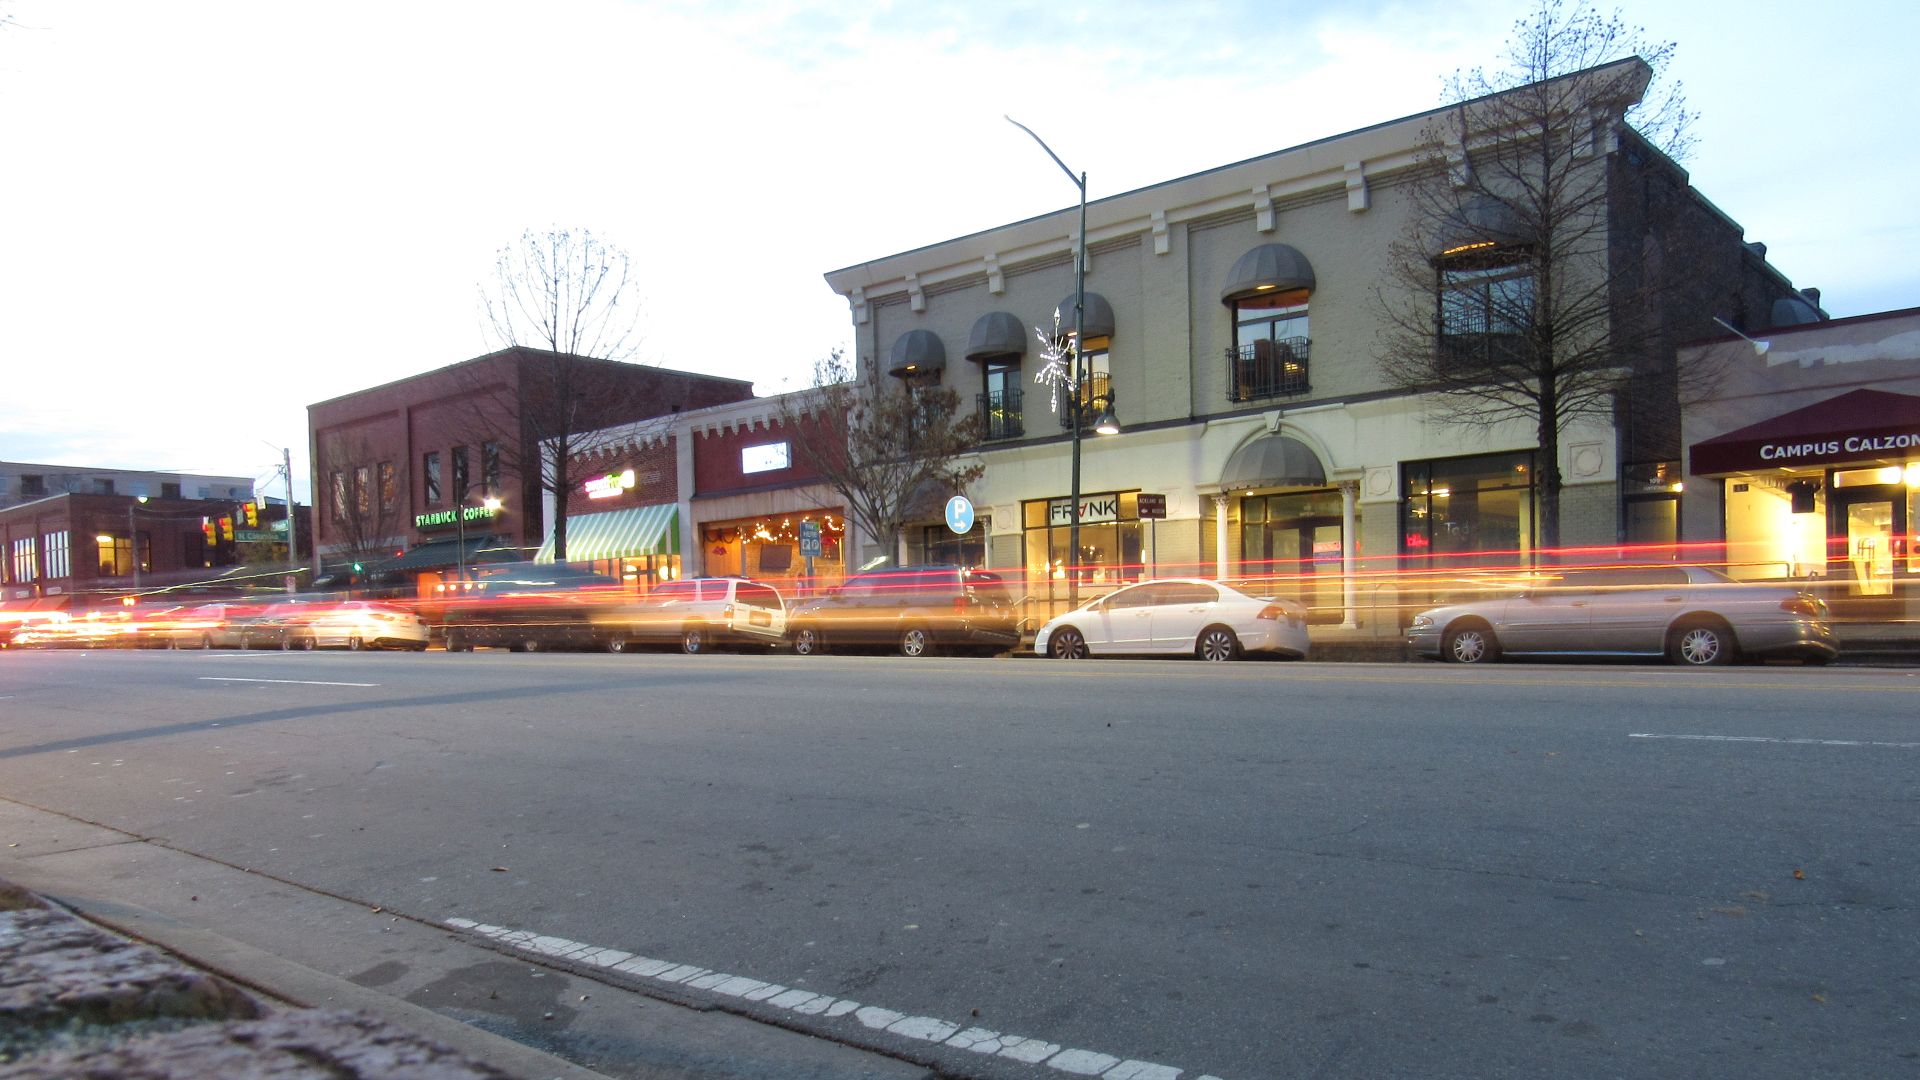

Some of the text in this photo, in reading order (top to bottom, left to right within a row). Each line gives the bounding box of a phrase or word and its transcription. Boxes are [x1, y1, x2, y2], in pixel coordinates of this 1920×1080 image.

[1760, 441, 1839, 460] CAMPUS
[415, 510, 461, 527] STARBUCK
[954, 500, 966, 519] P
